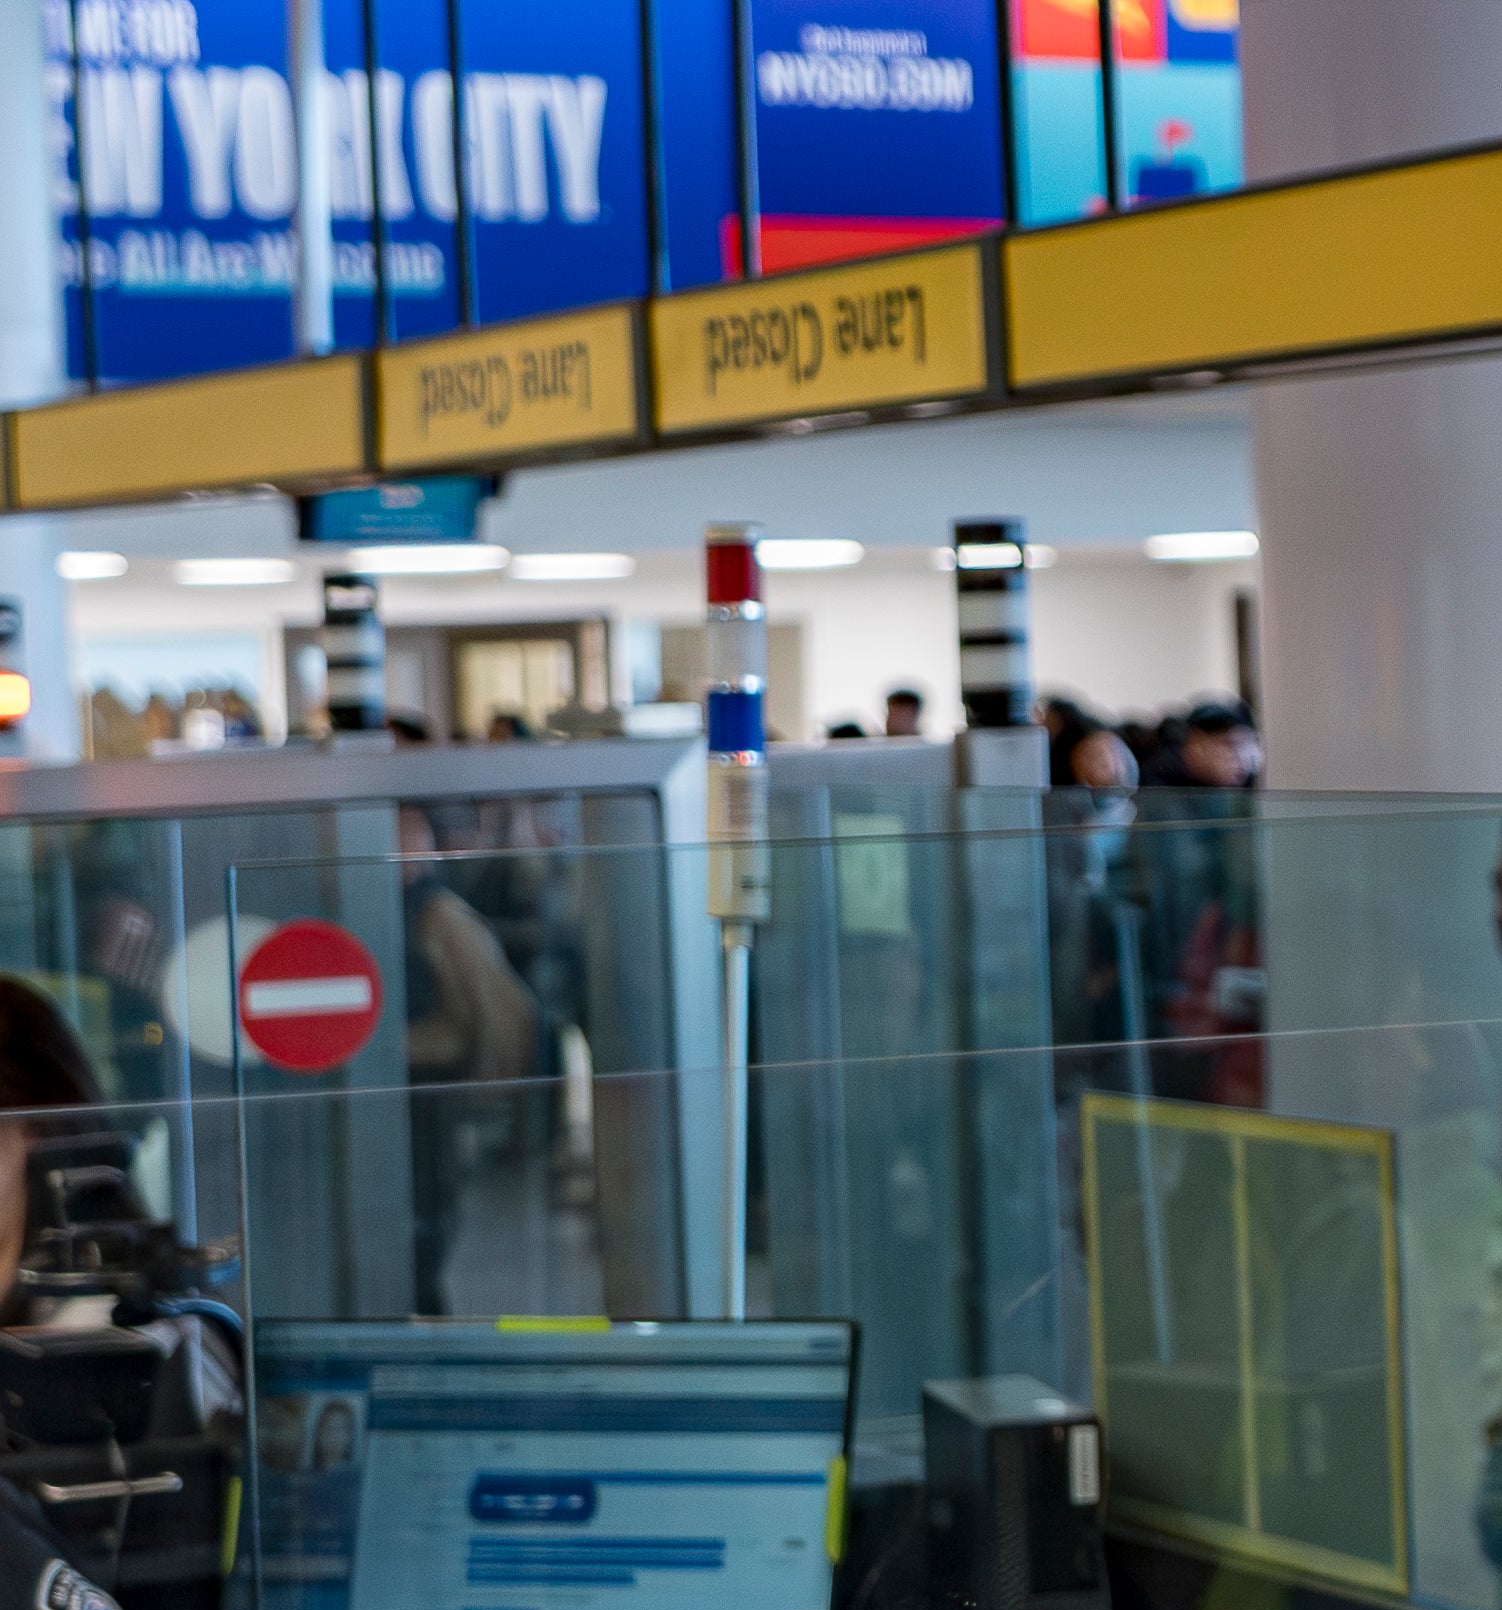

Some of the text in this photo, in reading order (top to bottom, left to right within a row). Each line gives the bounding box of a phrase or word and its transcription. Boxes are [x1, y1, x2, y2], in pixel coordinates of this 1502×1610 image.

[411, 69, 608, 223] CITY
[419, 340, 592, 438] Lane Closed
[703, 285, 926, 398] Lane Closed
